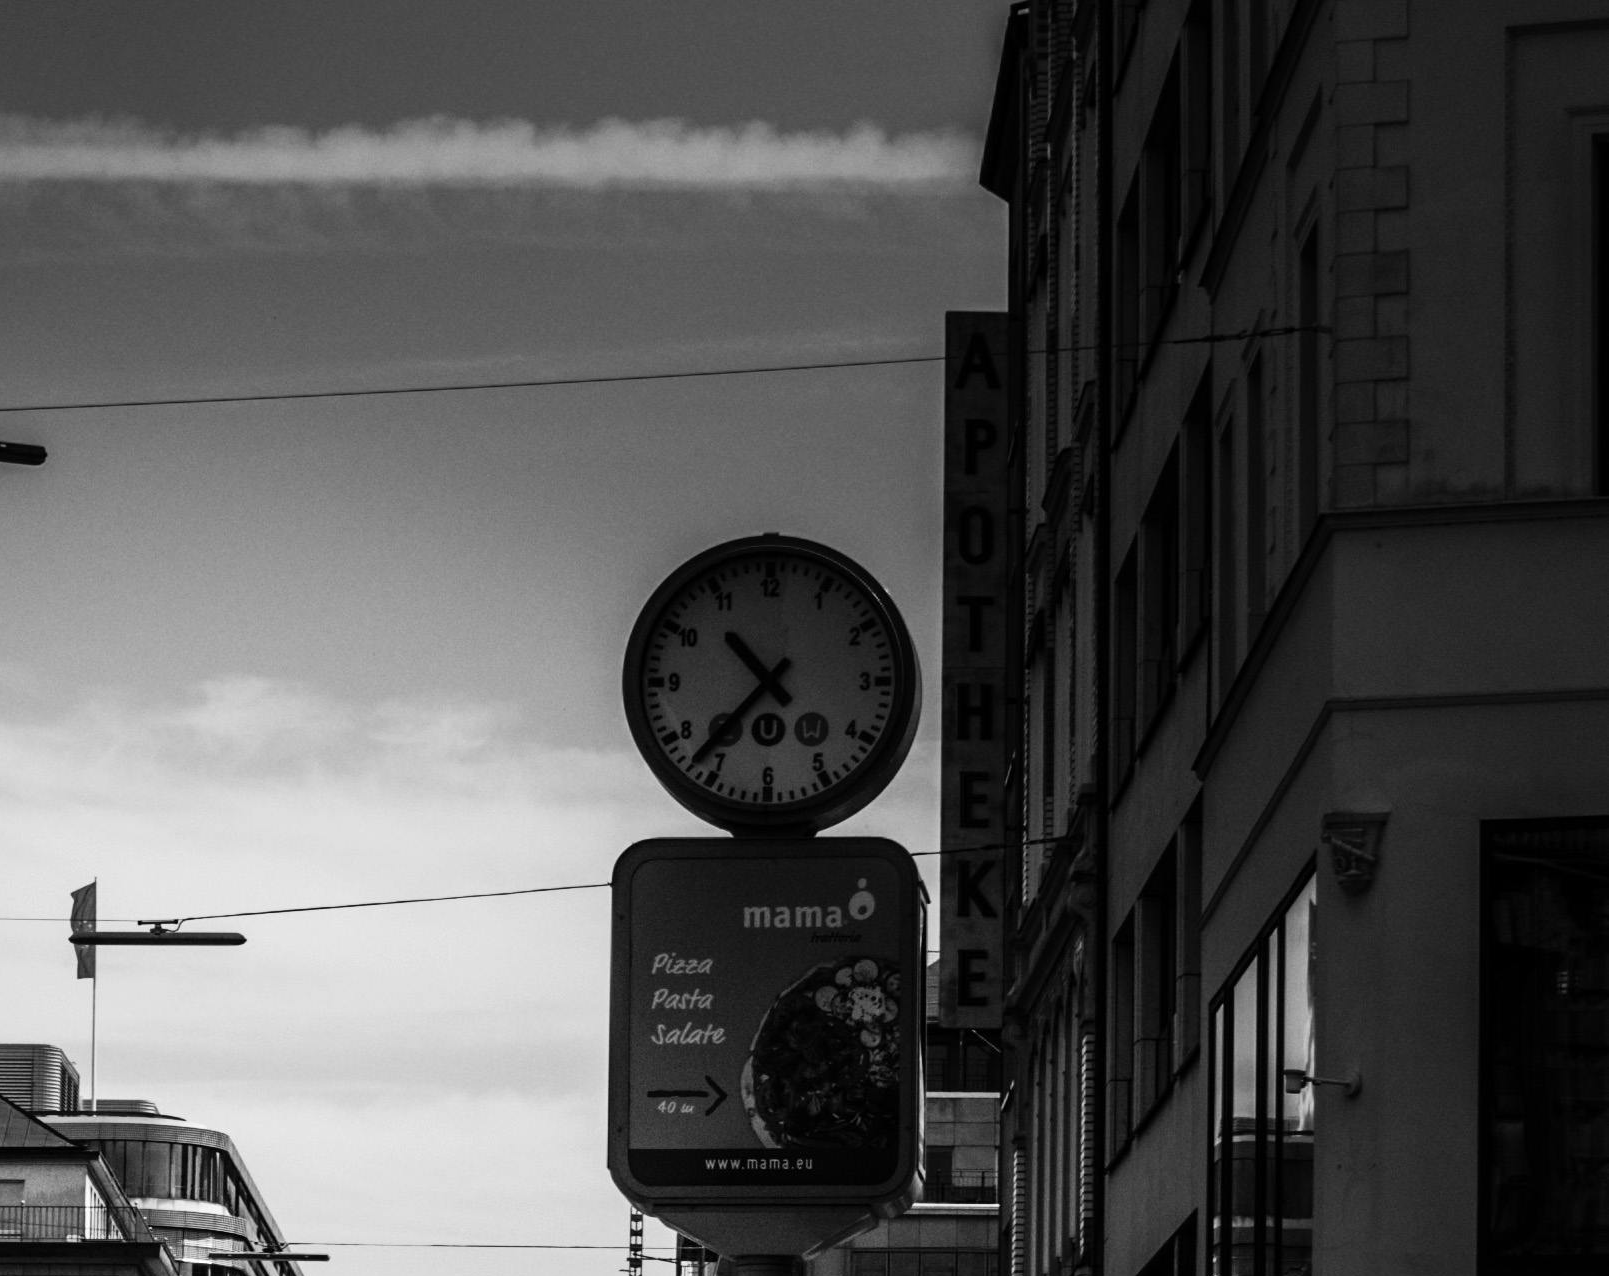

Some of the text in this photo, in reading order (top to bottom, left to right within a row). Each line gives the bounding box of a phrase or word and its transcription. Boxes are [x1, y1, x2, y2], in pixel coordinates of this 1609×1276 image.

[761, 579, 780, 597] 12
[715, 594, 732, 611] 11
[814, 593, 823, 609] 1
[679, 629, 697, 647] 10
[849, 628, 861, 646] 2
[955, 332, 1000, 1007] APOTHEKE
[668, 674, 680, 692] 9
[859, 674, 871, 691] 3
[680, 721, 692, 739] 8
[844, 720, 857, 738] 4
[715, 753, 726, 772] 7
[813, 752, 824, 771] 5
[762, 767, 774, 785] 6
[743, 905, 843, 929] mama
[651, 952, 714, 976] Pizza
[651, 987, 715, 1010] Pasta
[650, 1021, 727, 1046] Salate
[657, 1100, 676, 1114] 40
[704, 1157, 814, 1171] www.mama.eu
